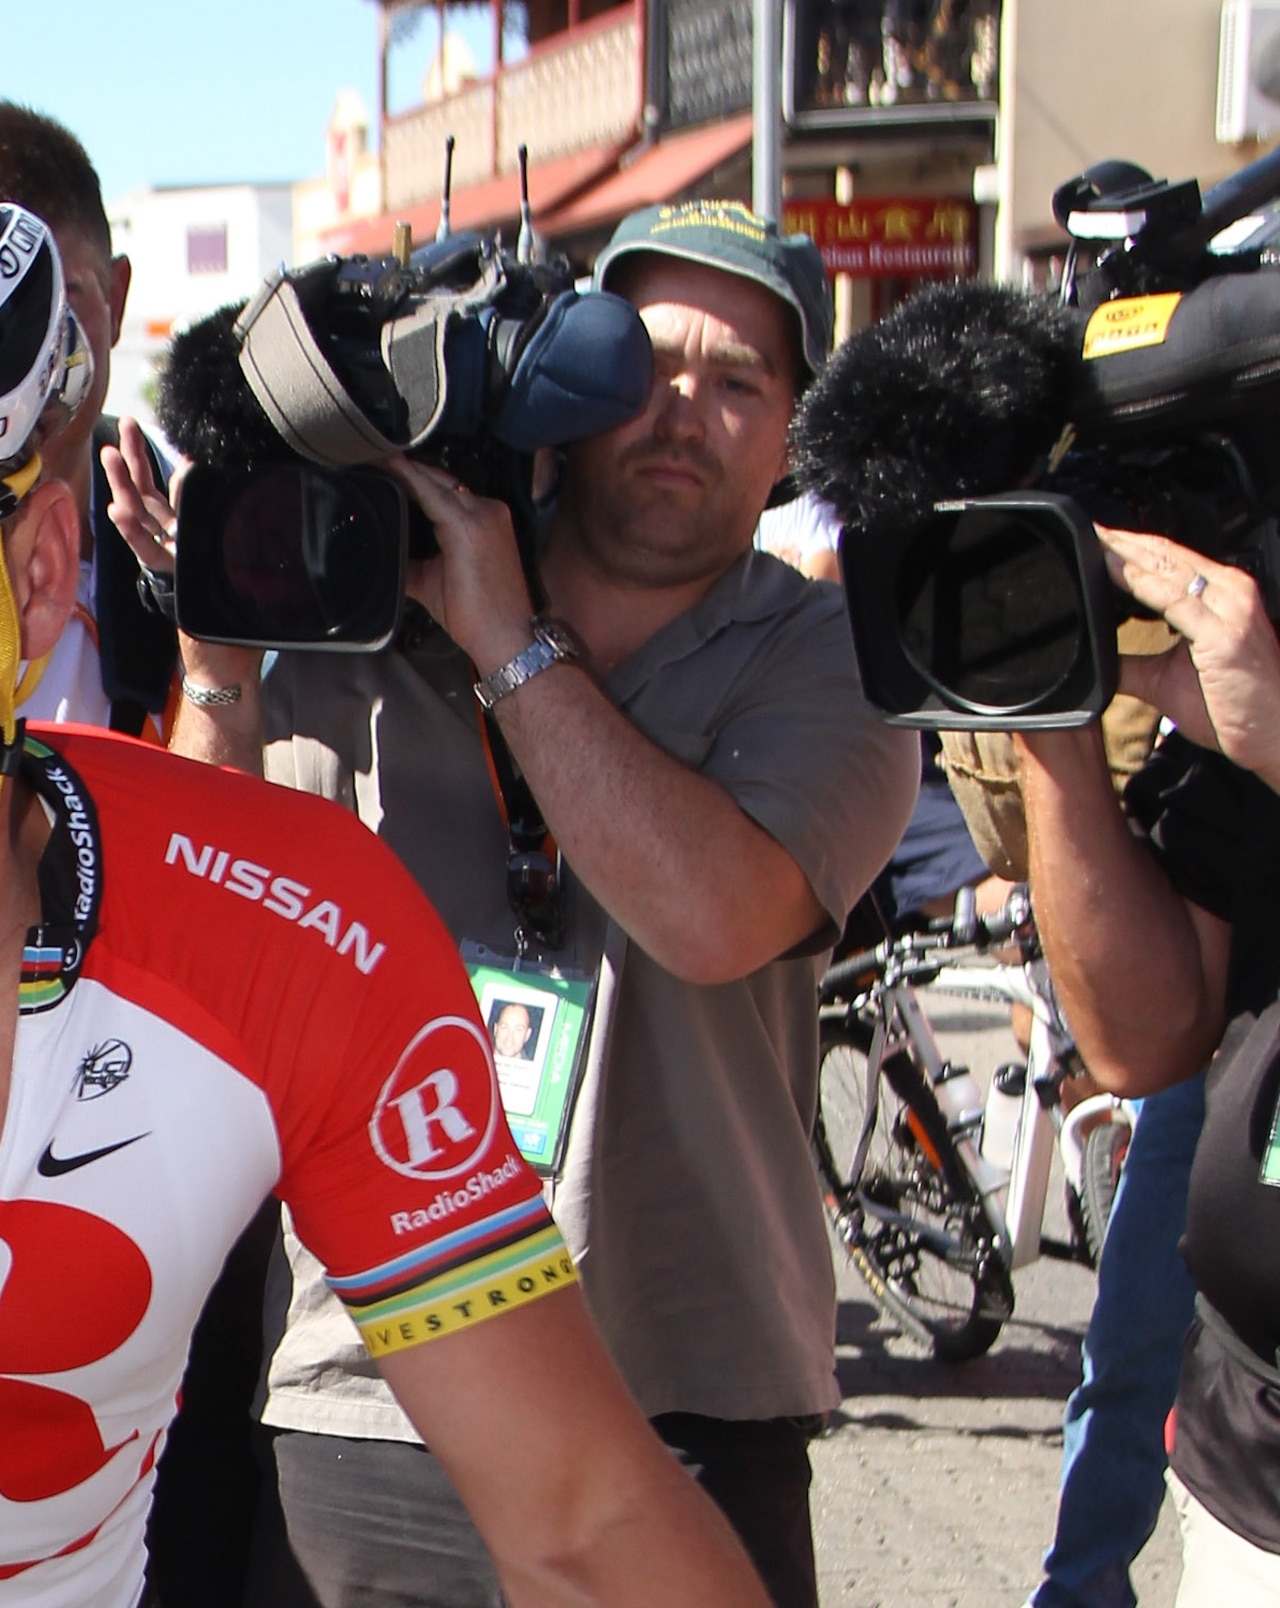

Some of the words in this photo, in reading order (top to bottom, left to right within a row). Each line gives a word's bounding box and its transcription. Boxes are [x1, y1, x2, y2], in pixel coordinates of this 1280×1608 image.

[164, 832, 387, 975] NISSAN
[551, 1022, 573, 1084] MEDIA
[390, 1154, 523, 1236] RadioShack
[369, 1257, 573, 1351] IVESTRONG
